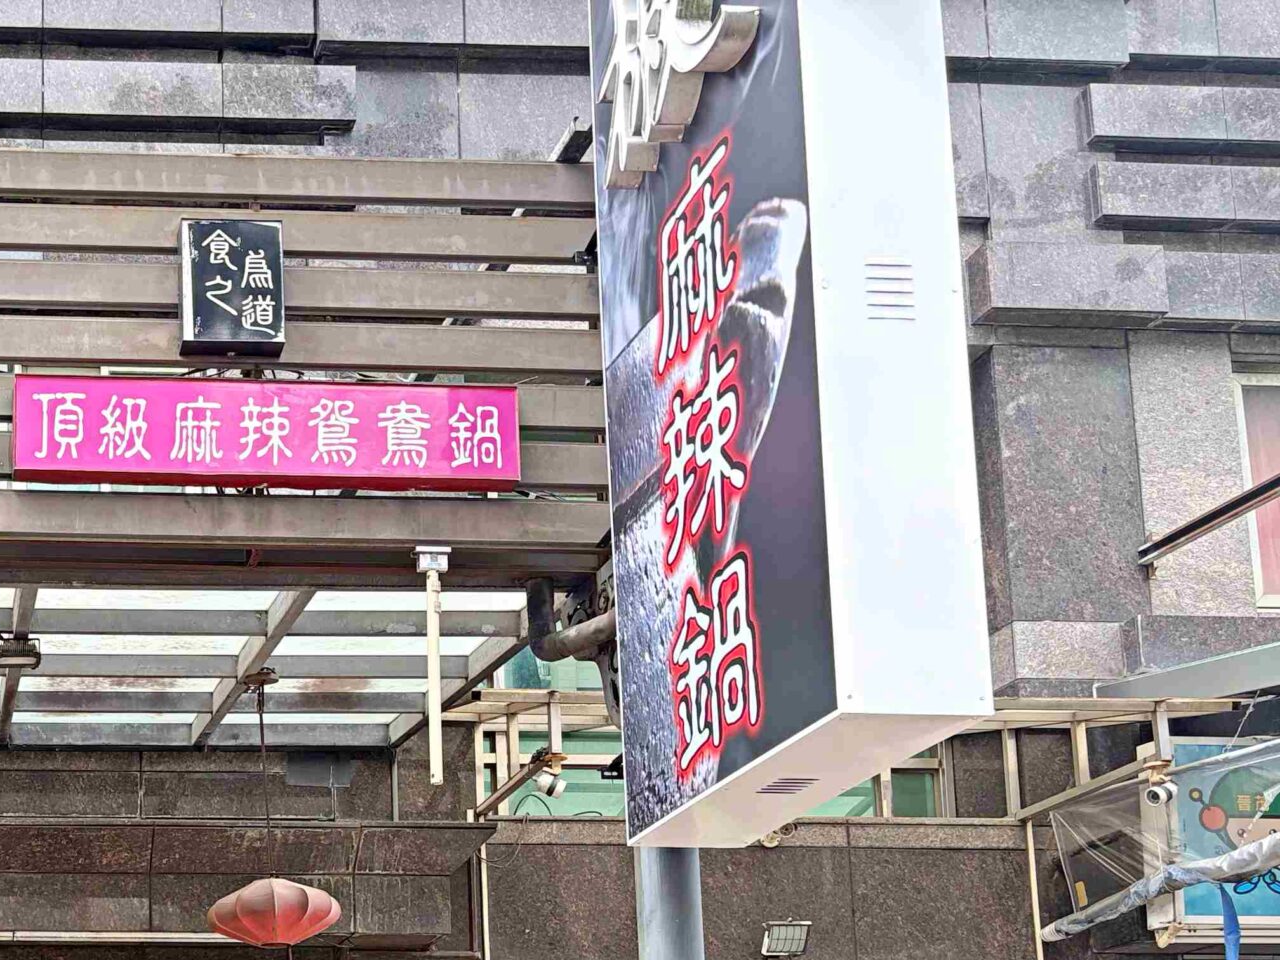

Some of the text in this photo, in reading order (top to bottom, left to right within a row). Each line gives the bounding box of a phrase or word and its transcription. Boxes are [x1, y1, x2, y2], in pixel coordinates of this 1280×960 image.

[32, 392, 503, 469] 頂級麻辣鴛鴦鍋
[658, 137, 757, 769] 麻辣鍋
